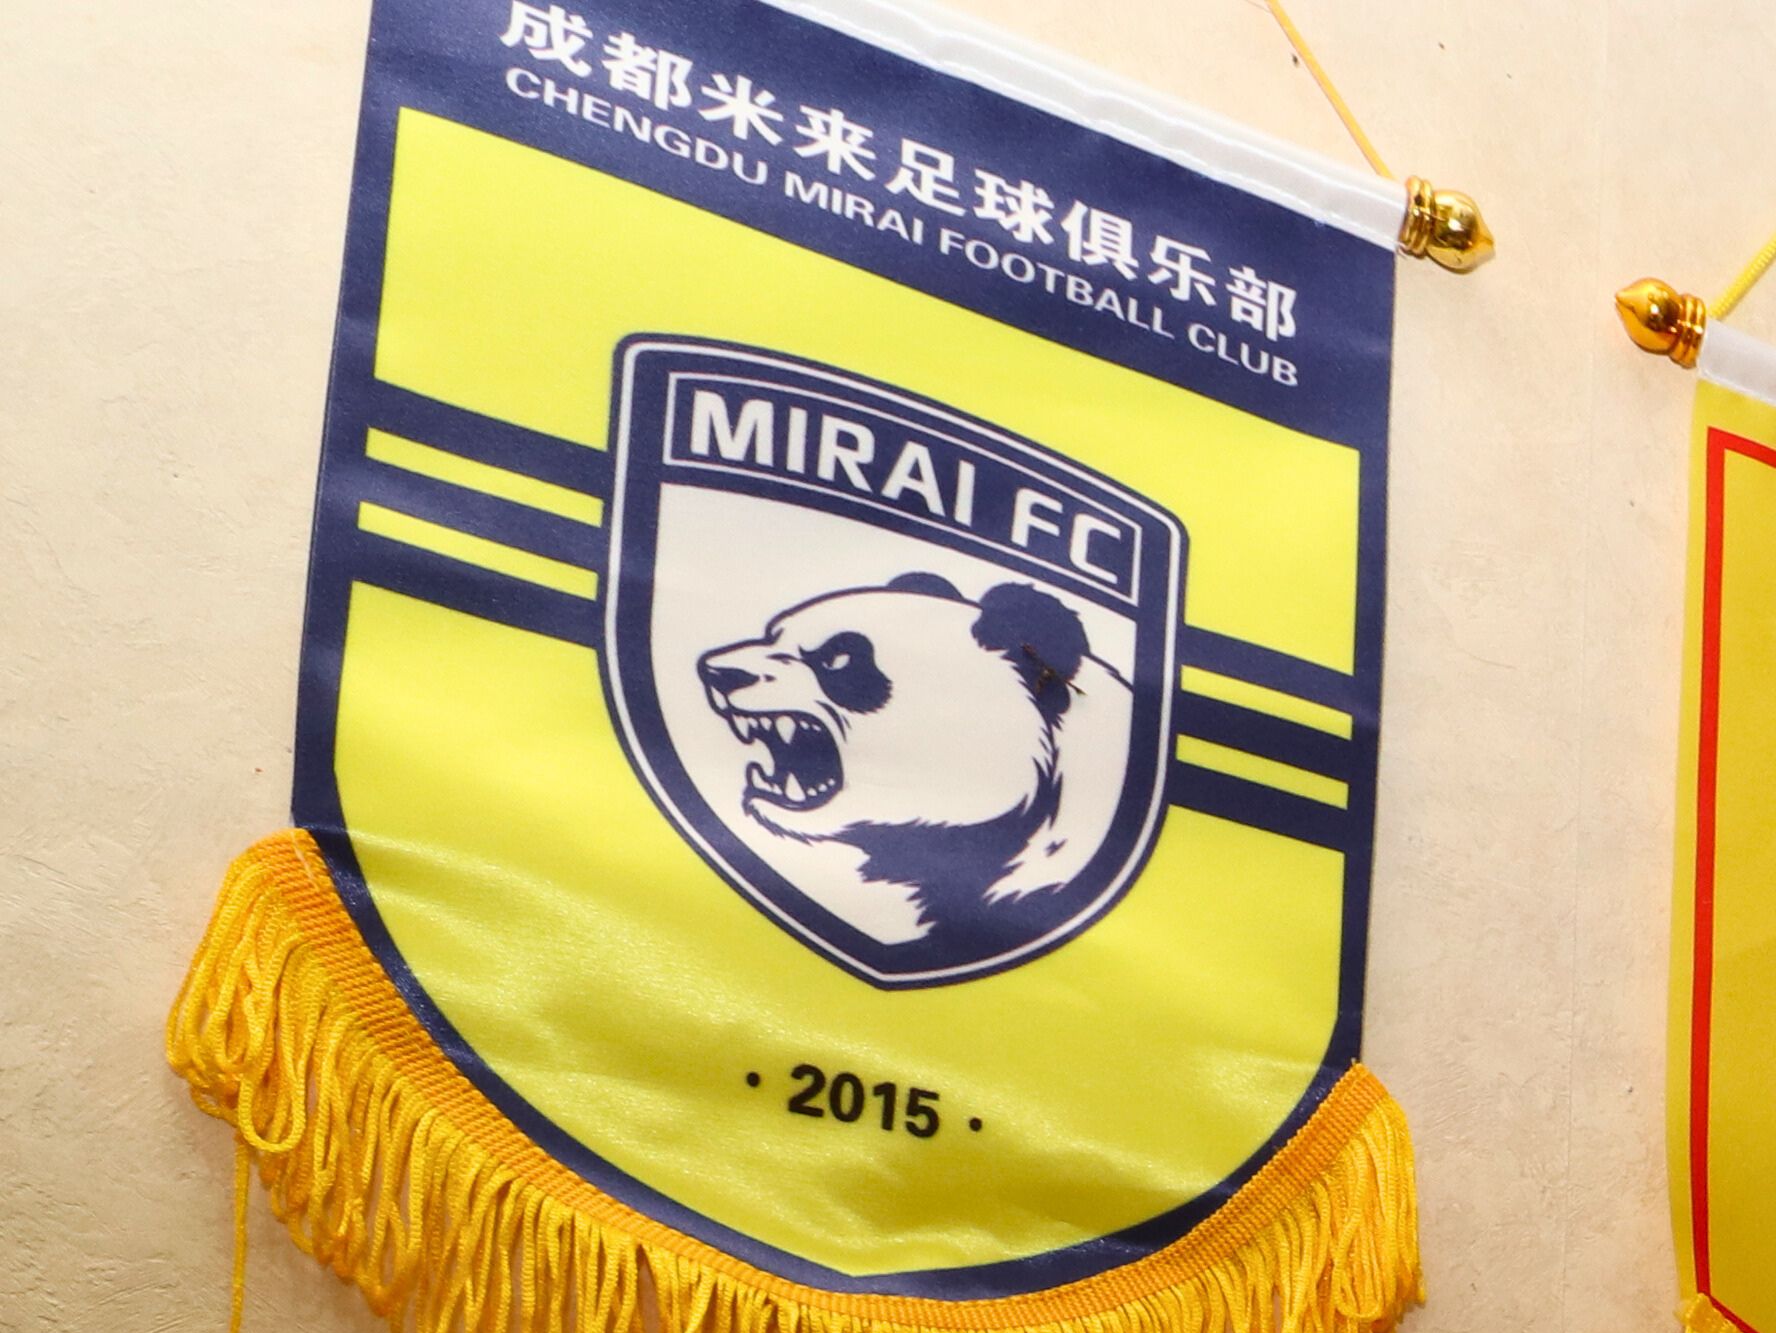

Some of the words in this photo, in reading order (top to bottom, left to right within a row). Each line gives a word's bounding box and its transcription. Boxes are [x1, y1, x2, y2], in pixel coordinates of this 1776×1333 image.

[500, 0, 1298, 341] 成都米来足球俱乐部
[504, 68, 768, 185] CHENGDU
[784, 169, 926, 243] MIRAI
[940, 217, 1175, 339] FOOTBALL
[1187, 315, 1300, 388] CLUB
[687, 389, 974, 528] MIRAI
[1009, 503, 1123, 586] FC
[787, 1064, 940, 1139] 2015
